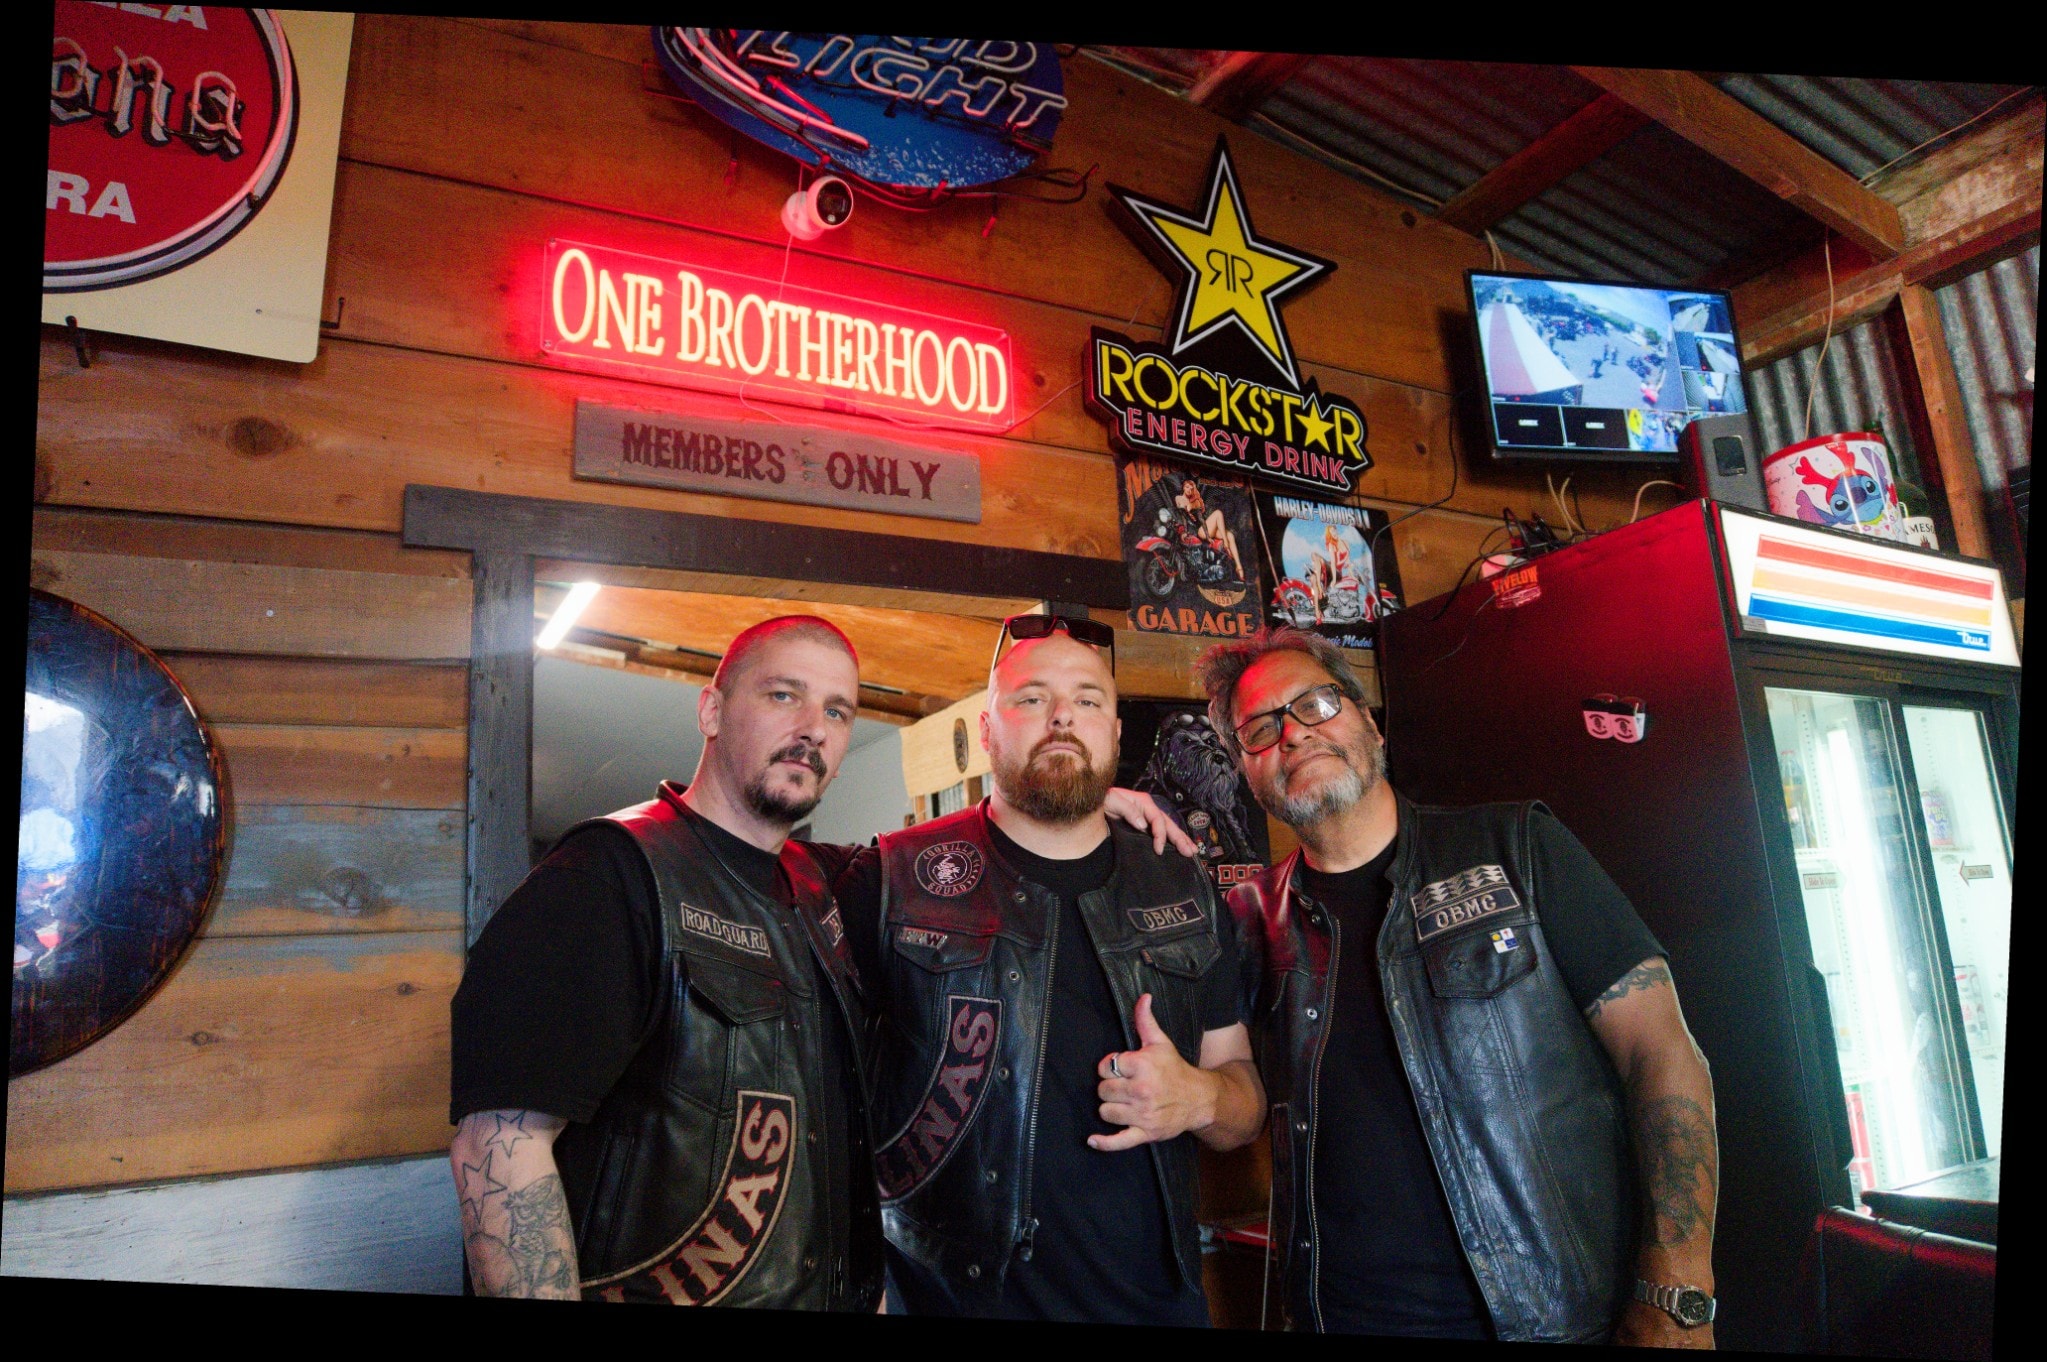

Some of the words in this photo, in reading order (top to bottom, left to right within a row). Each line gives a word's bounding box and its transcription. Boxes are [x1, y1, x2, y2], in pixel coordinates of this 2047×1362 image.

[737, 30, 1068, 129] LIGHT
[621, 421, 787, 484] MEMBERS
[824, 451, 941, 501] ONLY
[1127, 407, 1250, 461] ENERGY
[1264, 441, 1345, 483] DRINK
[1137, 604, 1255, 637] GARAGE
[685, 908, 722, 936] ROAD
[722, 924, 768, 950] GUARD
[1142, 906, 1188, 929] OBMC
[1435, 894, 1497, 928] OBMC
[601, 1100, 790, 1306] INAS
